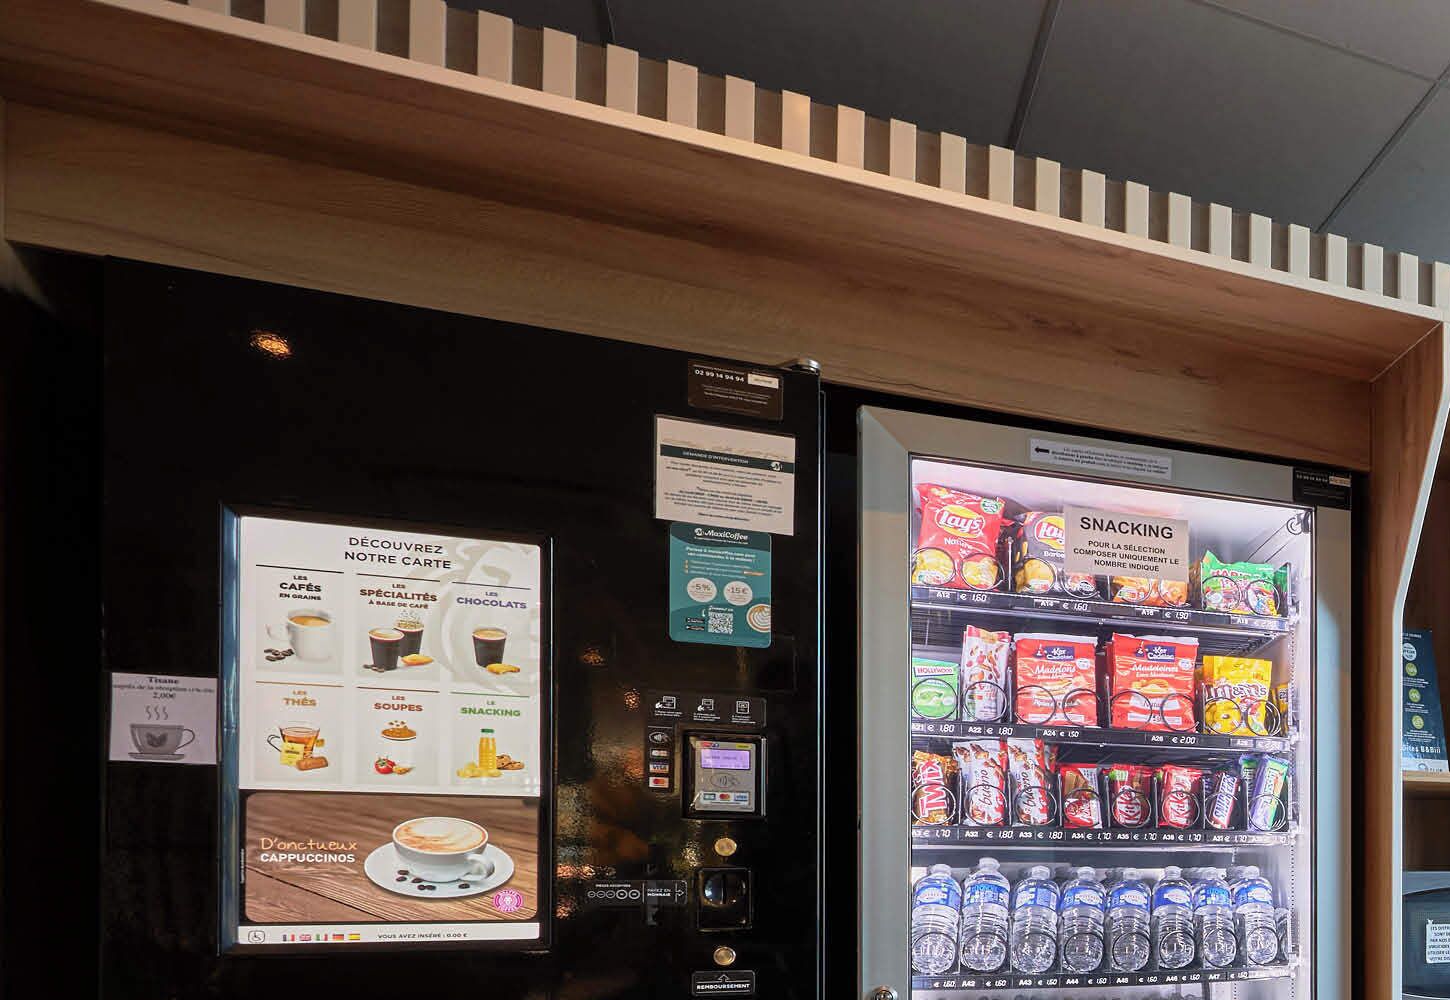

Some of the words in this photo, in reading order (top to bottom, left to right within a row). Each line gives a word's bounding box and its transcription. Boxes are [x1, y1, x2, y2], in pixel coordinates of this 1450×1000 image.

[1080, 516, 1174, 540] SNACKING
[704, 529, 749, 541] MaxiCoffee
[349, 536, 443, 555] DÉCOUVREZ
[1088, 540, 1110, 549] POUR
[1123, 544, 1166, 555] SÉLECTION
[344, 551, 397, 564] NOTRE
[401, 555, 452, 569] CARTE
[1073, 547, 1117, 559] COMPOSER
[1118, 553, 1168, 564] UNIQUEMENT
[1094, 559, 1127, 569] NOMBRE
[279, 582, 322, 592] CAFÉS
[359, 588, 438, 602] SPÉCIALITÉS
[936, 591, 951, 599] A12
[456, 596, 528, 609] CHOCOLATS
[283, 697, 318, 707] THÉS
[374, 702, 423, 712] SOUPES
[460, 706, 521, 717] SNACKING
[980, 768, 994, 806] bueno
[1020, 771, 1037, 808] bueno
[1071, 832, 1085, 840] A34
[260, 853, 355, 863] CAPPUCCINOS
